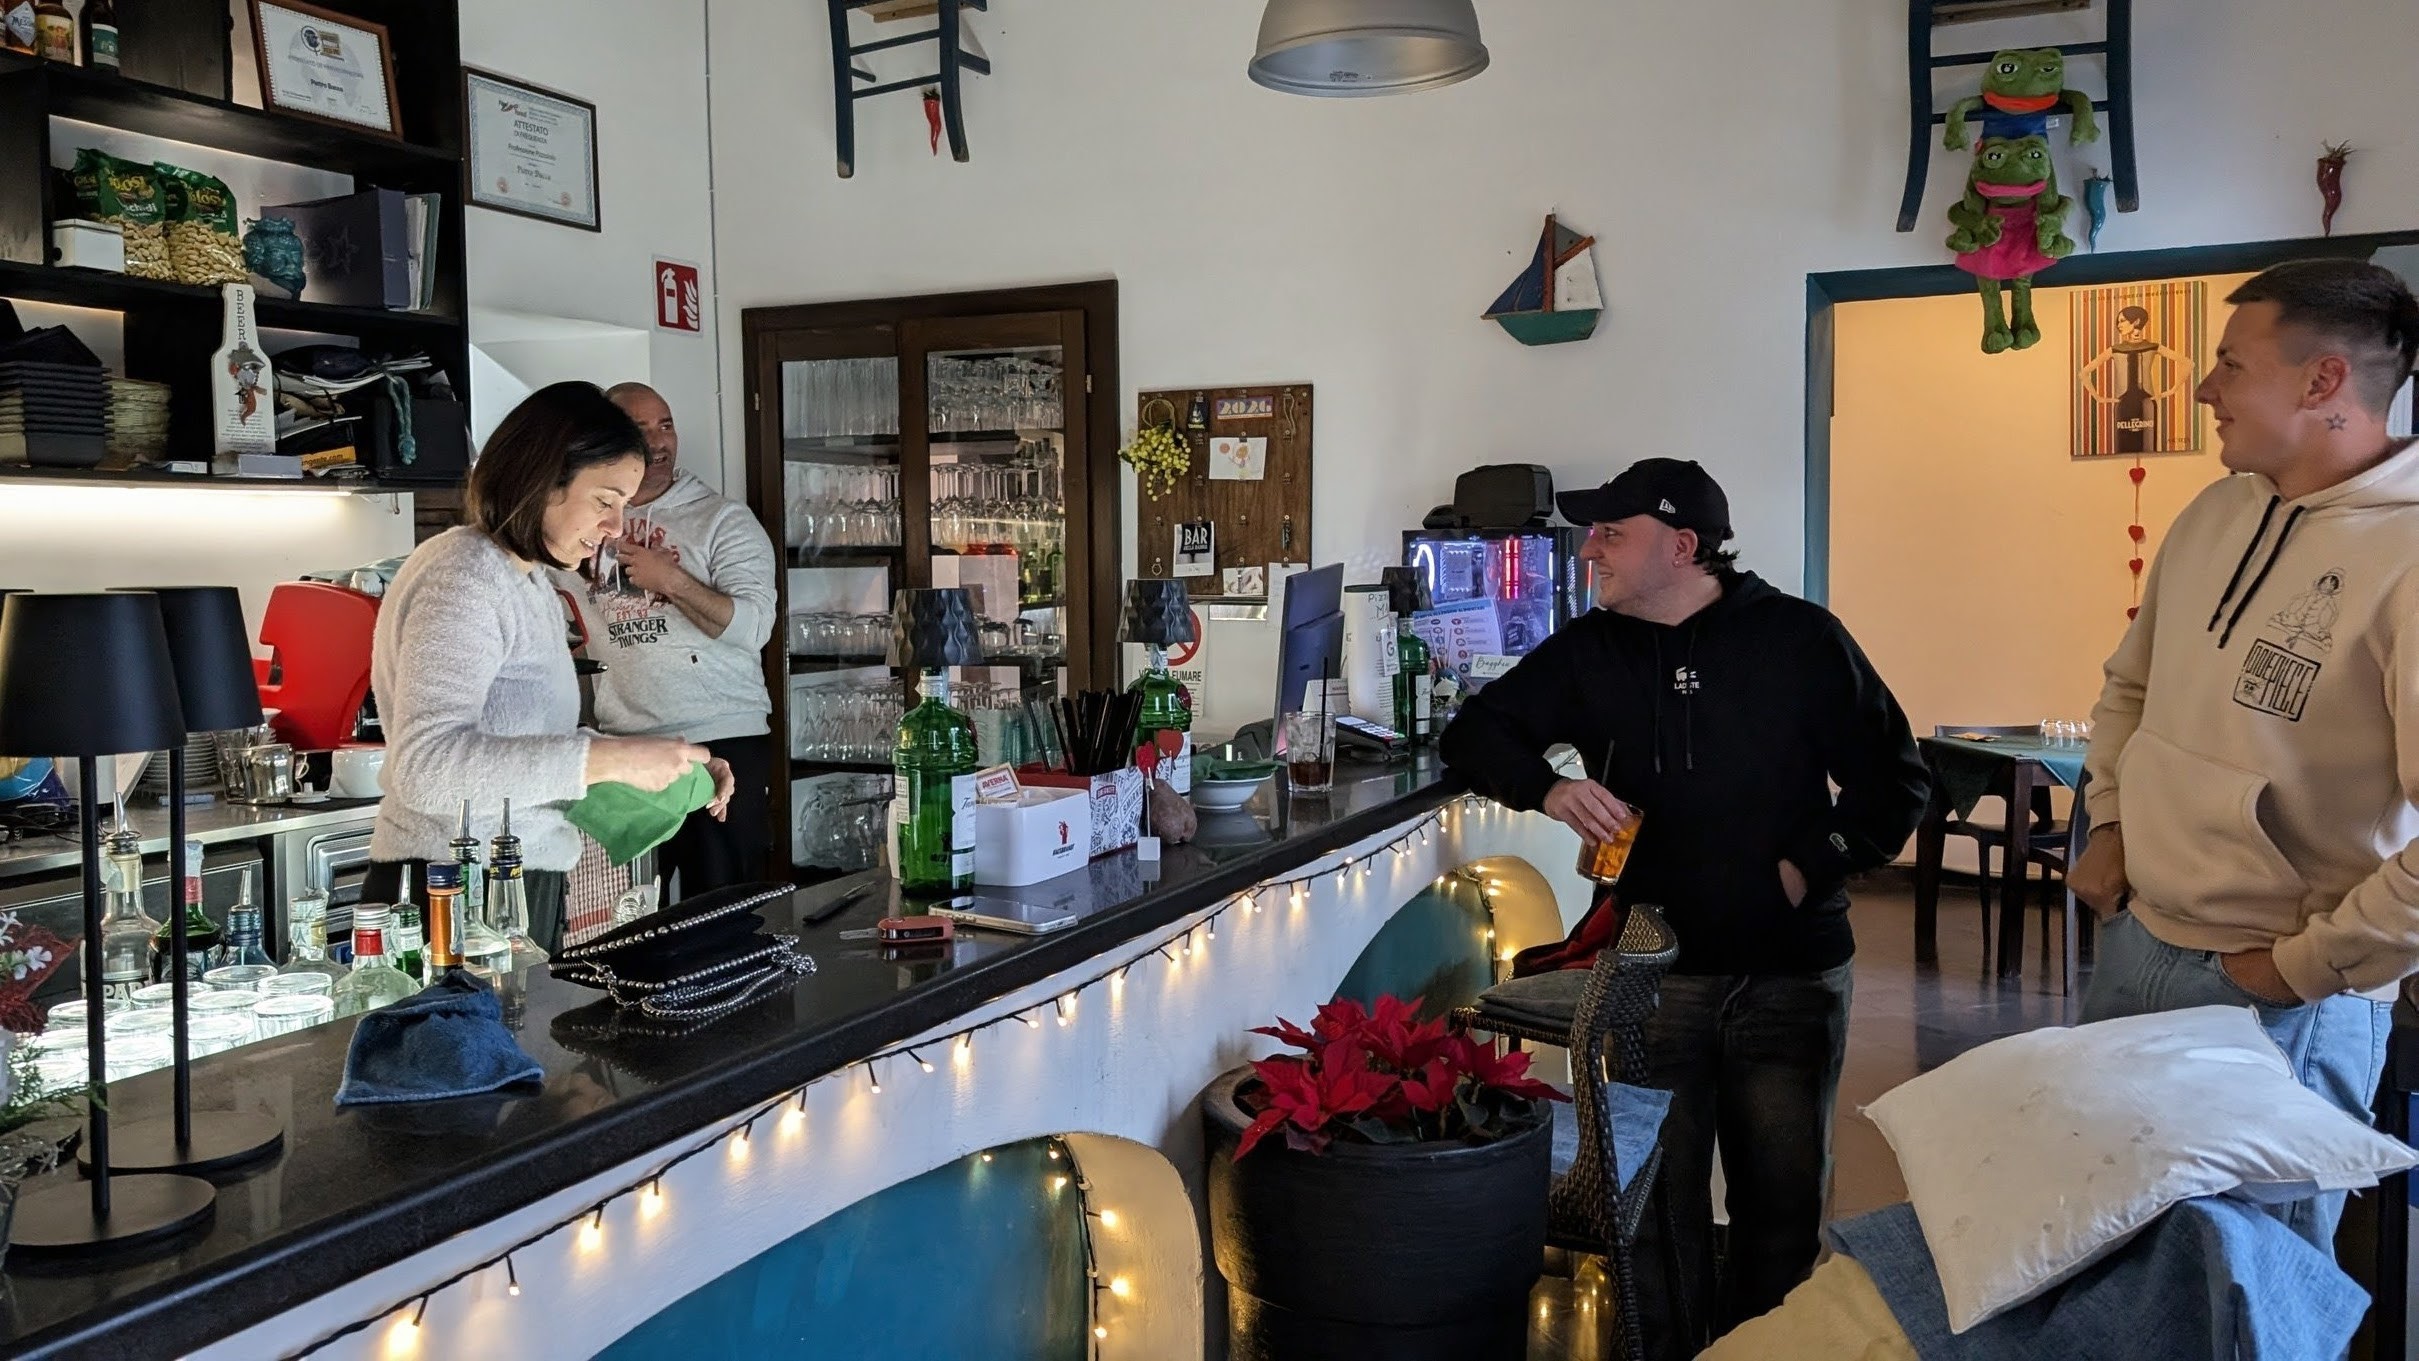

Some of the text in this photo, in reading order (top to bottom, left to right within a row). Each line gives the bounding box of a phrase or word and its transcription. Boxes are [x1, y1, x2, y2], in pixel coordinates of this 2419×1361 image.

[514, 120, 548, 136] ATTESTATO
[236, 289, 247, 341] BEER
[1184, 526, 1208, 546] BAR
[608, 618, 668, 642] STRANGER
[618, 632, 658, 648] THINGS
[2245, 645, 2279, 681] ONE
[1172, 670, 1202, 682] FUMARE
[2258, 655, 2314, 716] PIECE
[982, 775, 1008, 788] AVERNA
